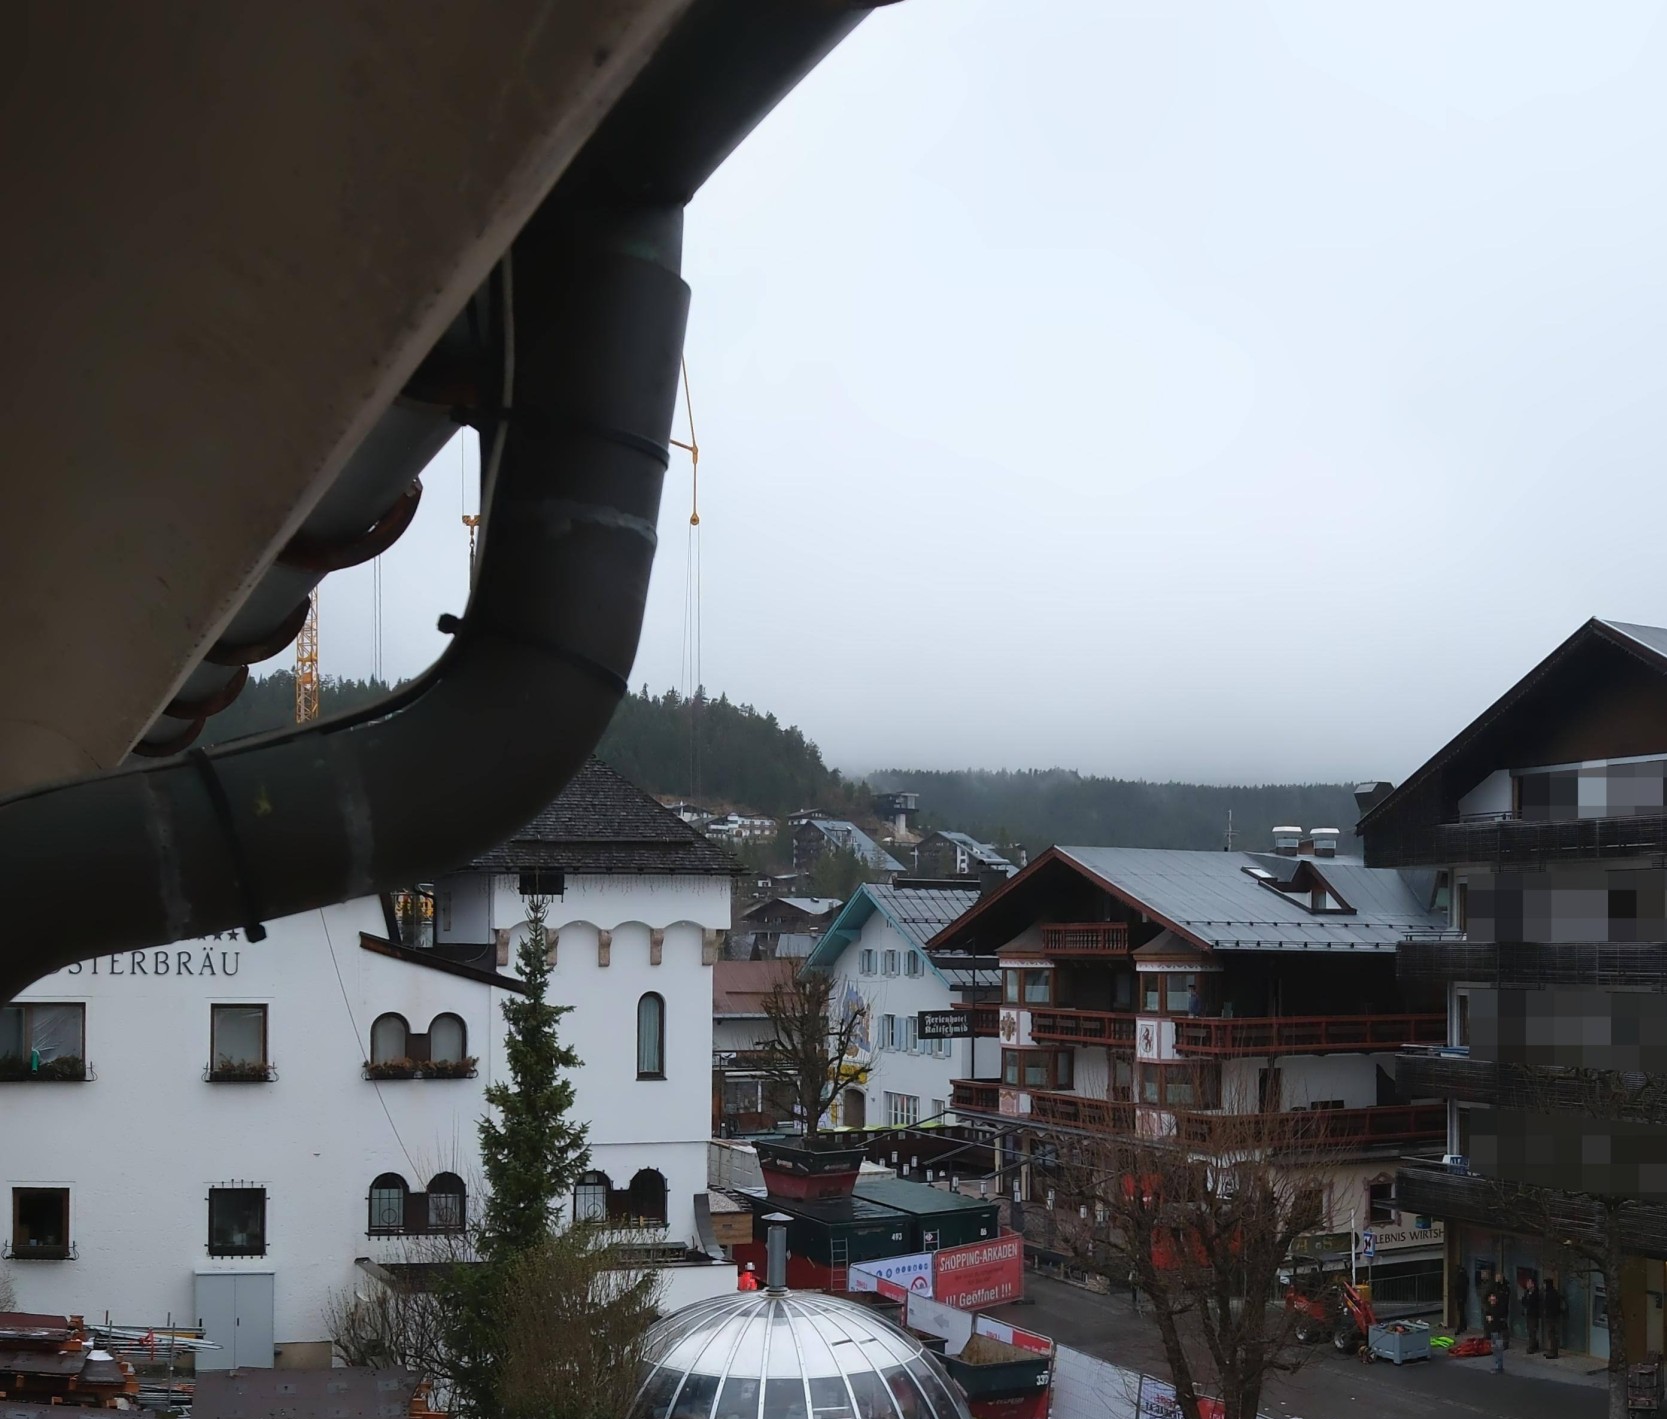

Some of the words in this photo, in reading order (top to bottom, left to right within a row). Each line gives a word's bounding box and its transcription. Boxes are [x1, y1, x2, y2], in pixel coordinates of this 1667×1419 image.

[54, 947, 240, 976] STERBRÄU
[939, 1242, 1018, 1272] SHOPPING-ARKADEN
[959, 1287, 999, 1307] Geöffnet
